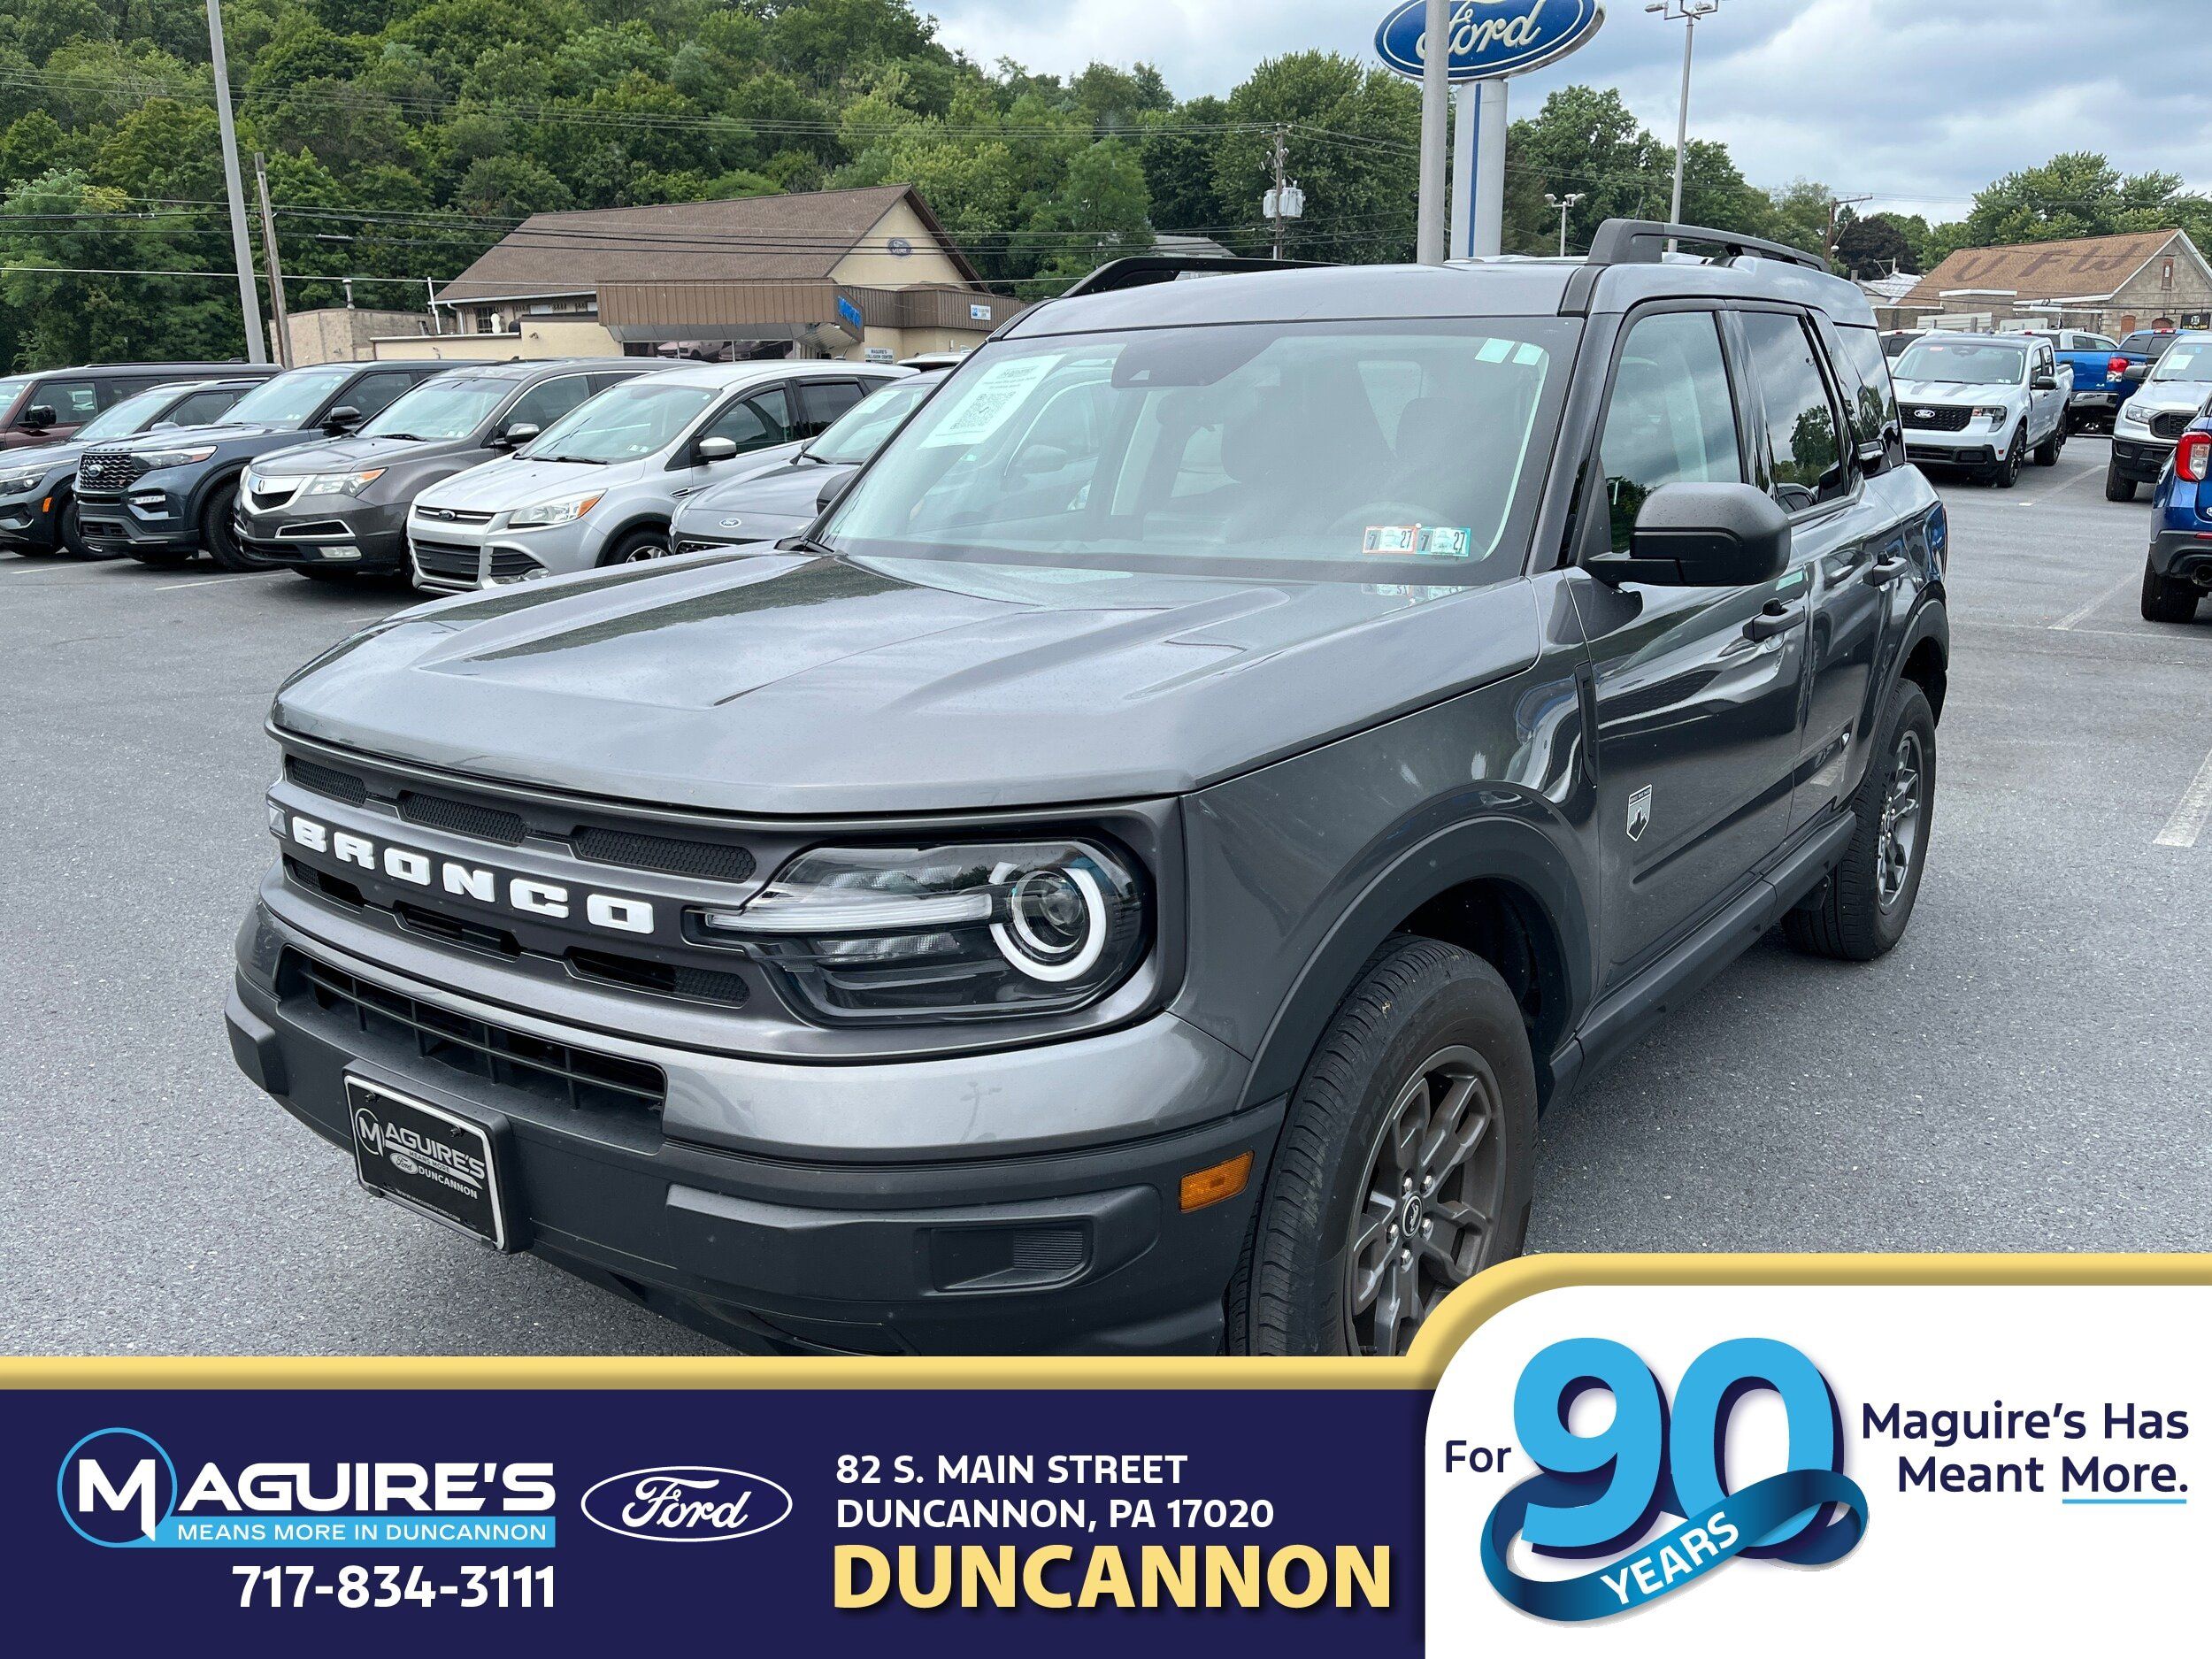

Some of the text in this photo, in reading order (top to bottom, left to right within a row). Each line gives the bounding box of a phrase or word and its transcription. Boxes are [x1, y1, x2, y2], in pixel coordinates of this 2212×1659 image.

[1400, 530, 1413, 549] 27
[1453, 531, 1465, 550] 27
[291, 816, 656, 935] BRONCO
[359, 1116, 486, 1180] MAGUIRE'S
[409, 1150, 451, 1174] MEANS MORE
[418, 1165, 479, 1200] DUNCANNON
